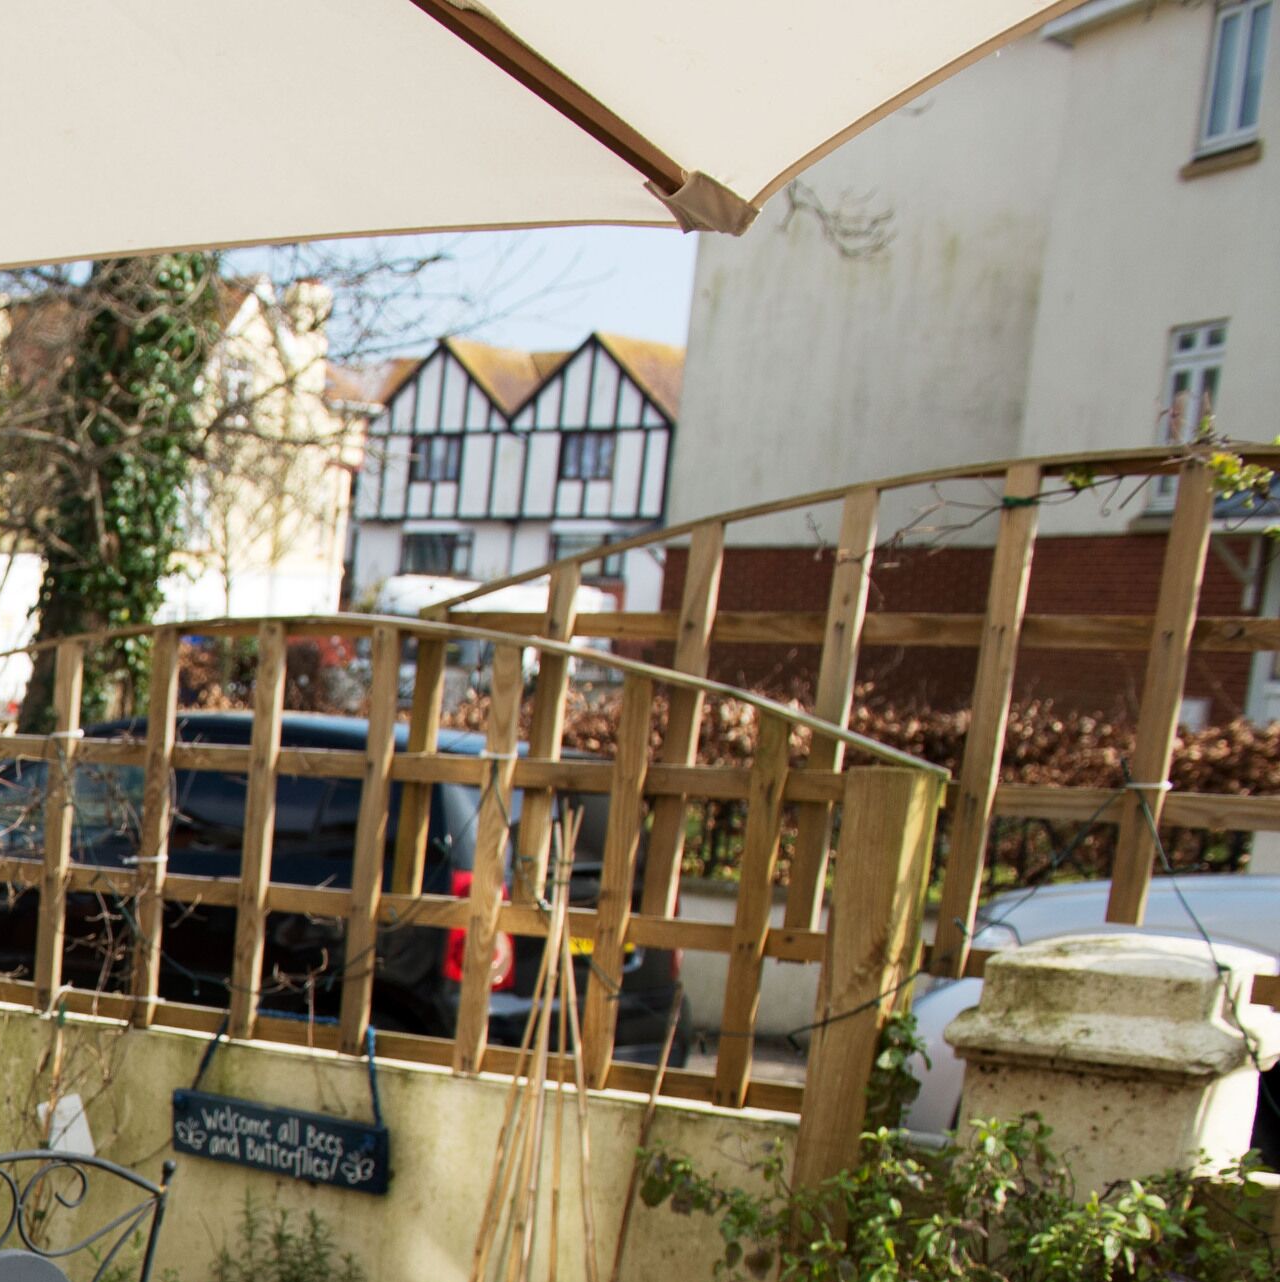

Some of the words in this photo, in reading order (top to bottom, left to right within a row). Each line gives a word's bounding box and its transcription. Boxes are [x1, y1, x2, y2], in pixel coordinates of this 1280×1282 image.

[201, 1106, 272, 1139] Welcome
[277, 1118, 300, 1147] all
[306, 1125, 344, 1157] Bees
[209, 1134, 240, 1159] and
[246, 1137, 340, 1180] Butterflies!
